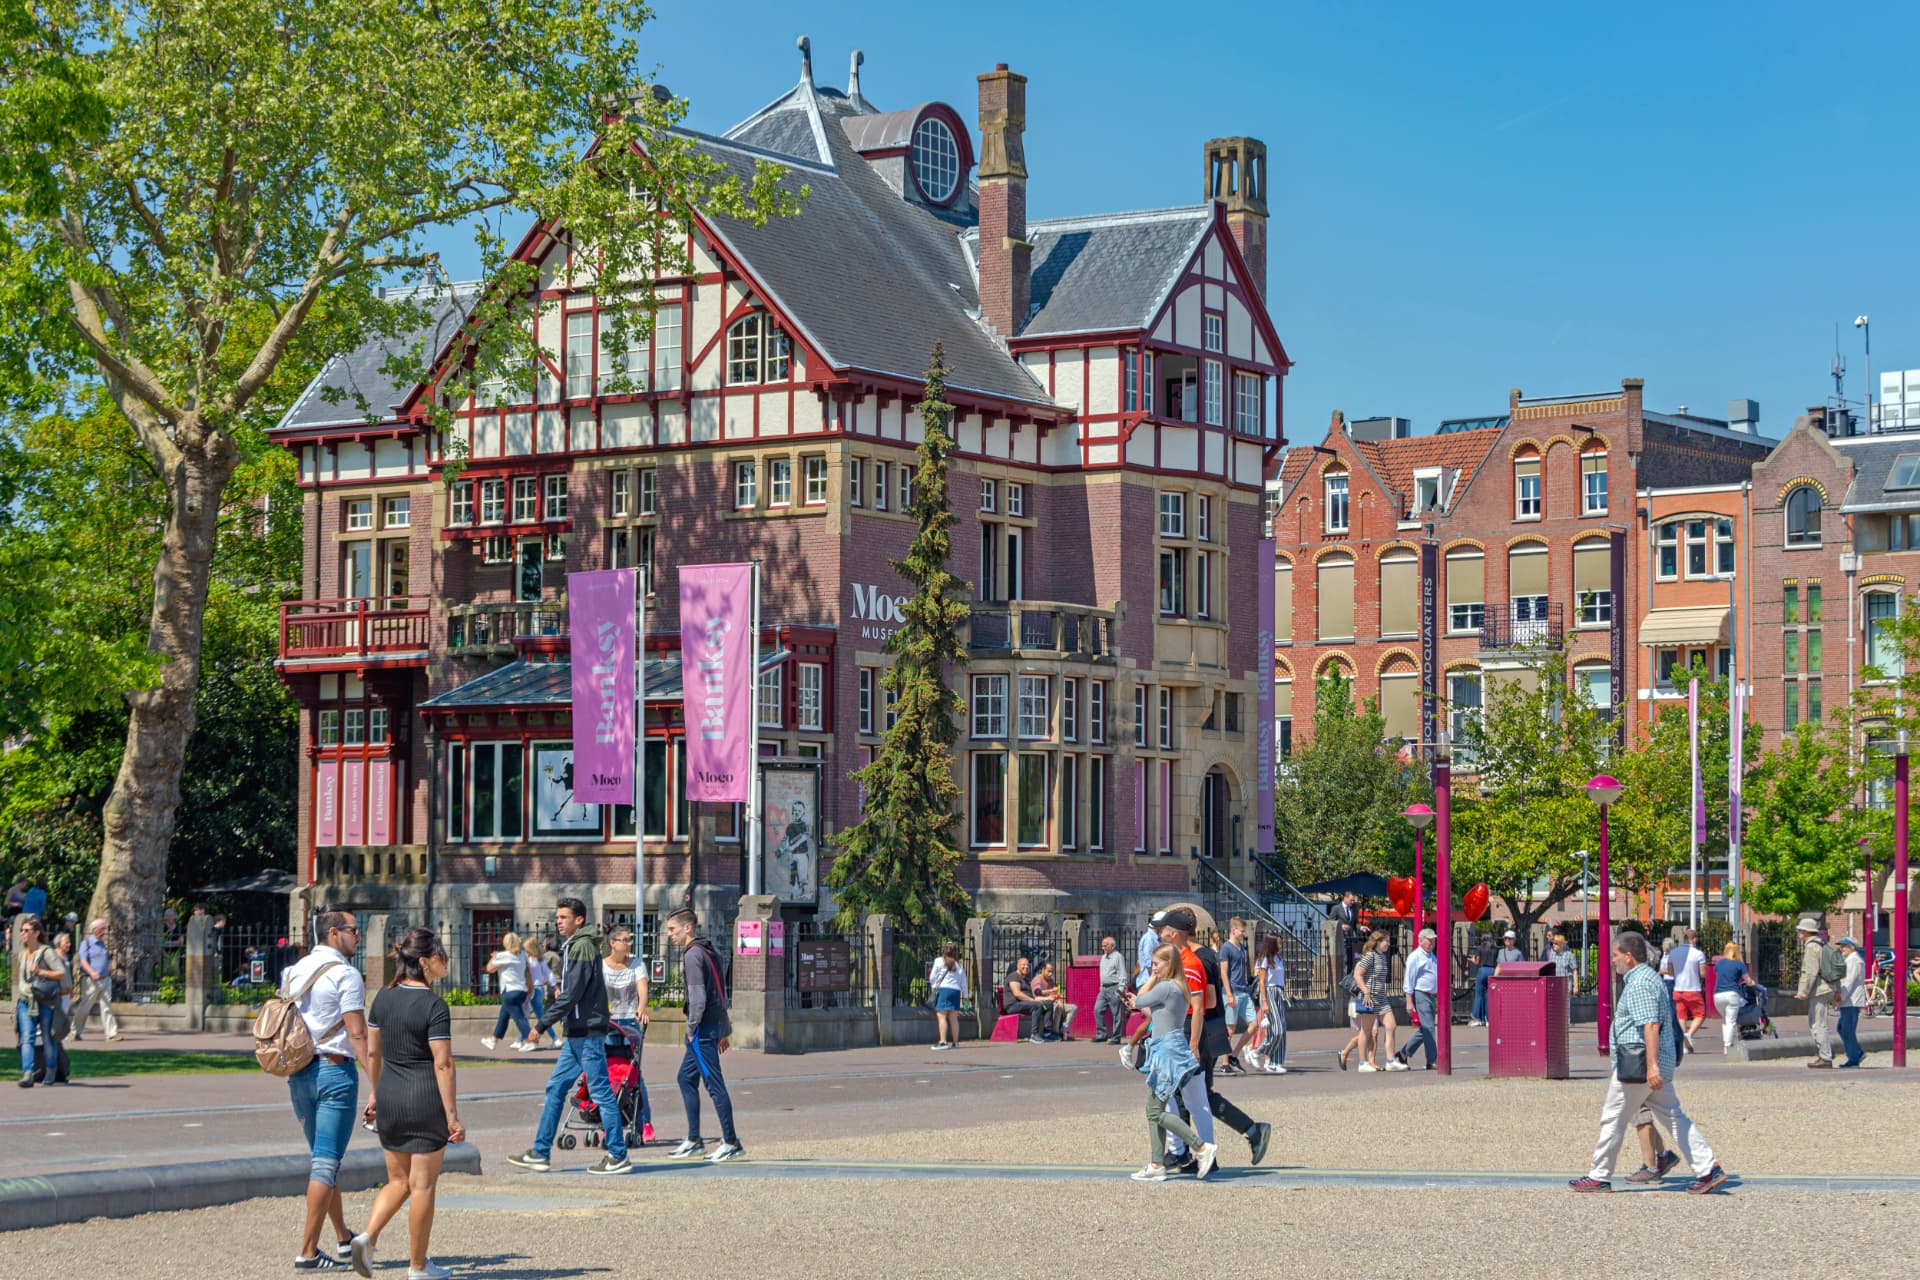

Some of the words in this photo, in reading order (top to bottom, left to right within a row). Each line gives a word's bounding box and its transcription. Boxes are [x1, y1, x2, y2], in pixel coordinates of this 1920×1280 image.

[850, 583, 908, 623] Moc
[862, 625, 899, 640] MUSE
[1423, 577, 1432, 706] HEADQUARTERS
[592, 618, 620, 743] Banksy
[697, 617, 731, 740] Banksy
[591, 773, 622, 786] Moco
[697, 771, 734, 783] Moco
